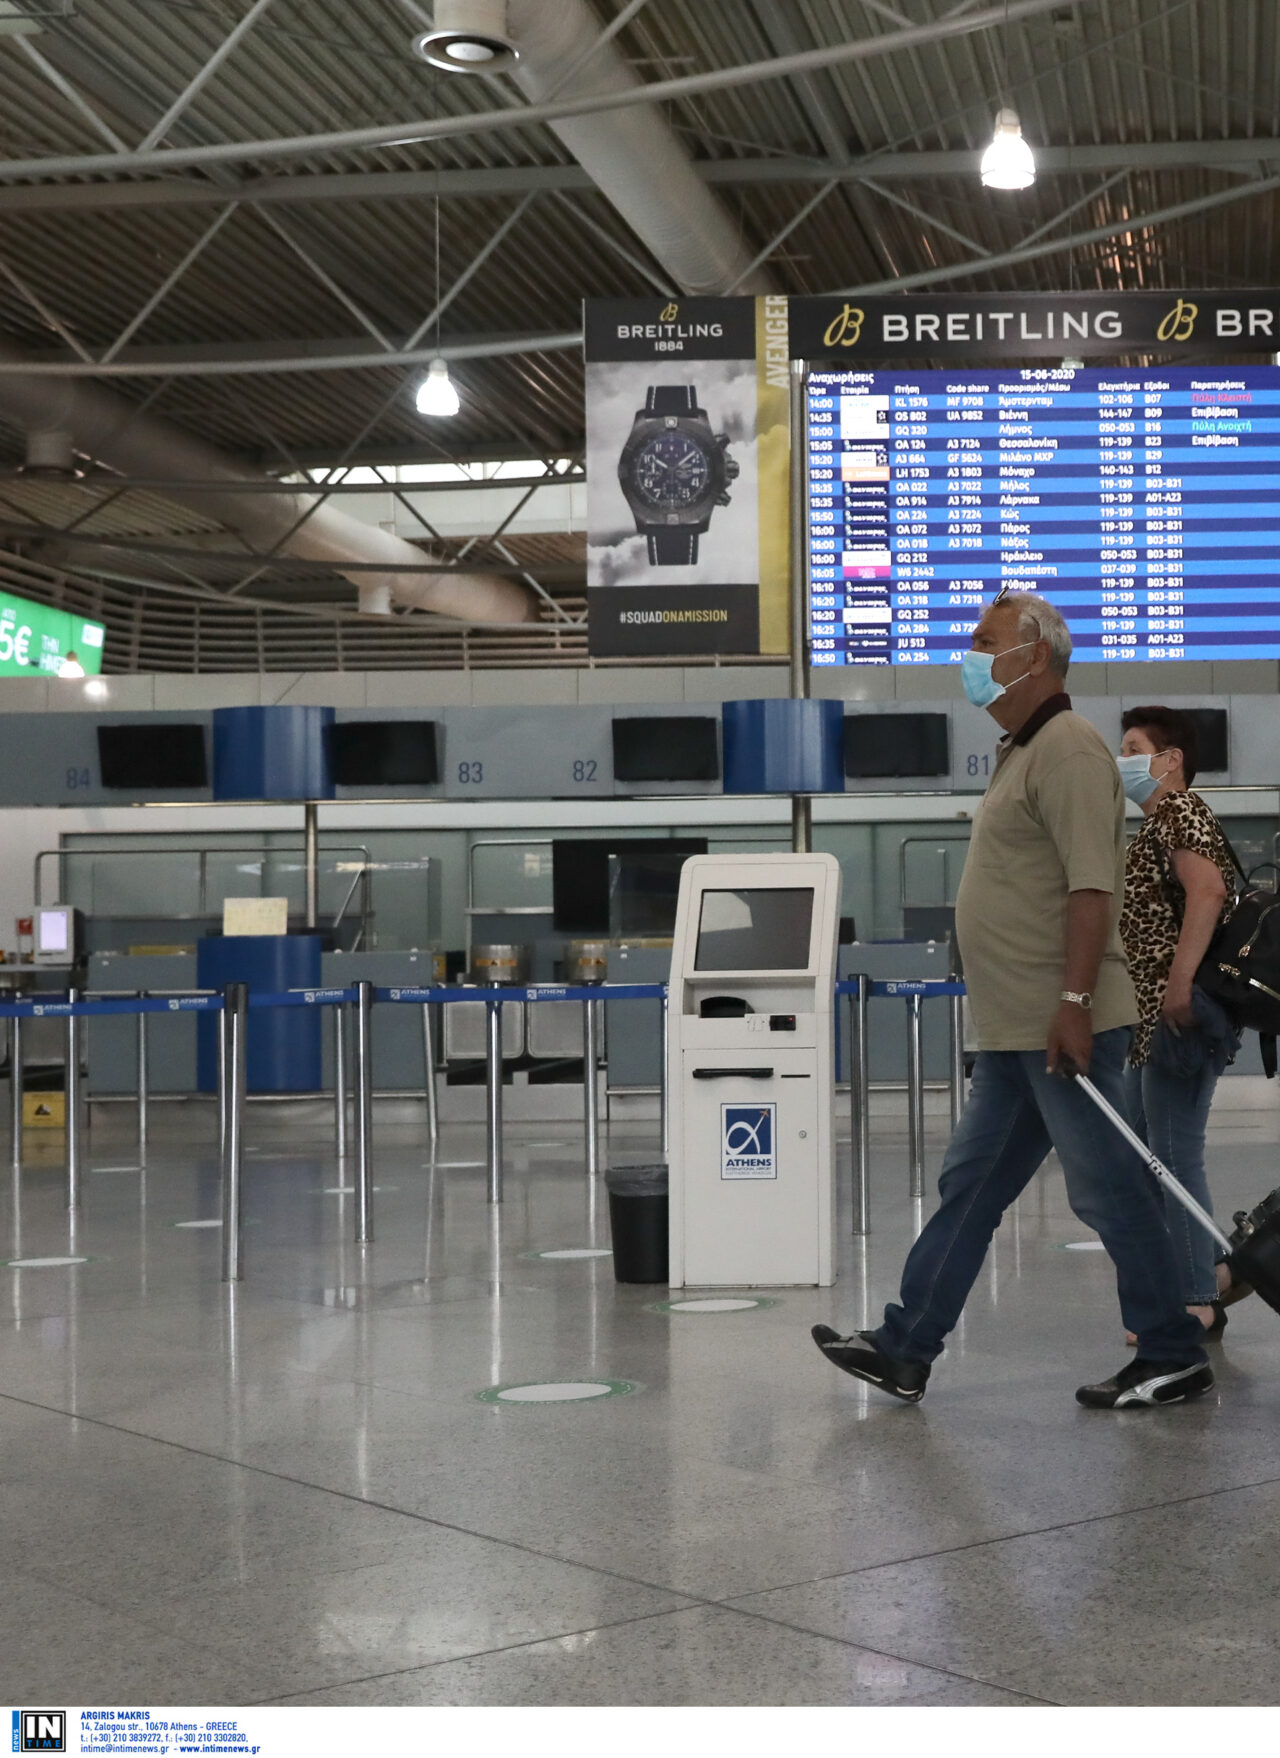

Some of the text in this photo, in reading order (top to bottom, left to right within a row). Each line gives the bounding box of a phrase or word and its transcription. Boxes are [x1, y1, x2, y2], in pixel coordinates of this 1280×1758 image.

[617, 323, 723, 339] BREITLING
[883, 310, 1123, 343] BREITLING
[654, 341, 684, 351] 1884
[765, 295, 790, 389] AVENGER
[808, 371, 874, 384] Αναχωρήσεις
[1021, 369, 1075, 379] 15-06-2020
[809, 399, 833, 408] 14:00
[810, 413, 832, 422] 14:35
[1192, 407, 1238, 418] Επιβίβαση
[809, 427, 833, 436] 15:00
[810, 441, 832, 450] 15:05
[895, 440, 909, 449] OA
[911, 440, 925, 449] 124
[947, 440, 958, 448] A3
[961, 439, 980, 448] 7124
[1100, 437, 1132, 446] 119-139
[1192, 435, 1238, 446] Επιβίβαση
[809, 455, 833, 464] 15:20
[896, 454, 907, 463] A3
[1100, 451, 1132, 460] 119-139
[810, 470, 832, 478] 15:20
[911, 468, 929, 477] 1753
[948, 468, 959, 477] A3
[619, 609, 728, 624] #SQUADONAMISSION
[910, 638, 925, 647] 513
[573, 760, 598, 782] 82
[967, 754, 988, 776] 81
[66, 768, 90, 790] 84
[458, 762, 483, 784] 83
[726, 1158, 772, 1167] ATHENS
